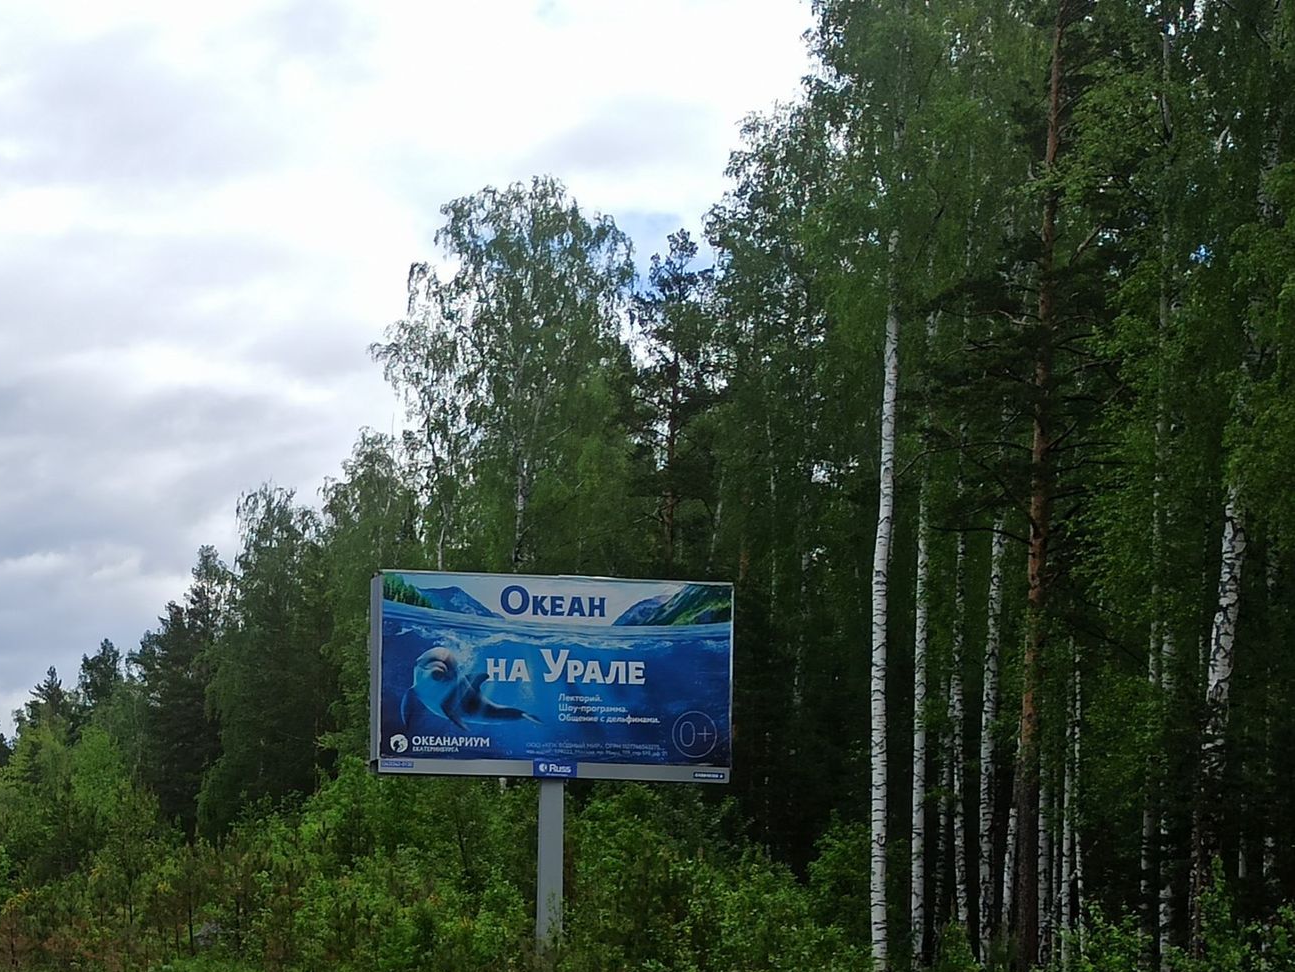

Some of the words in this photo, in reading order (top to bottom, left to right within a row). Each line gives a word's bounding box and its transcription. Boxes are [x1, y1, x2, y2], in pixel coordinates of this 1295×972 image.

[558, 692, 603, 703] Лекторий.
[558, 703, 629, 714] Шоу-программа.
[558, 713, 599, 723] Общение
[606, 714, 660, 725] дельфинами.
[680, 721, 713, 748] 0+
[412, 735, 490, 748] ОКЕАНАРИУМ
[549, 763, 571, 774] Russ
